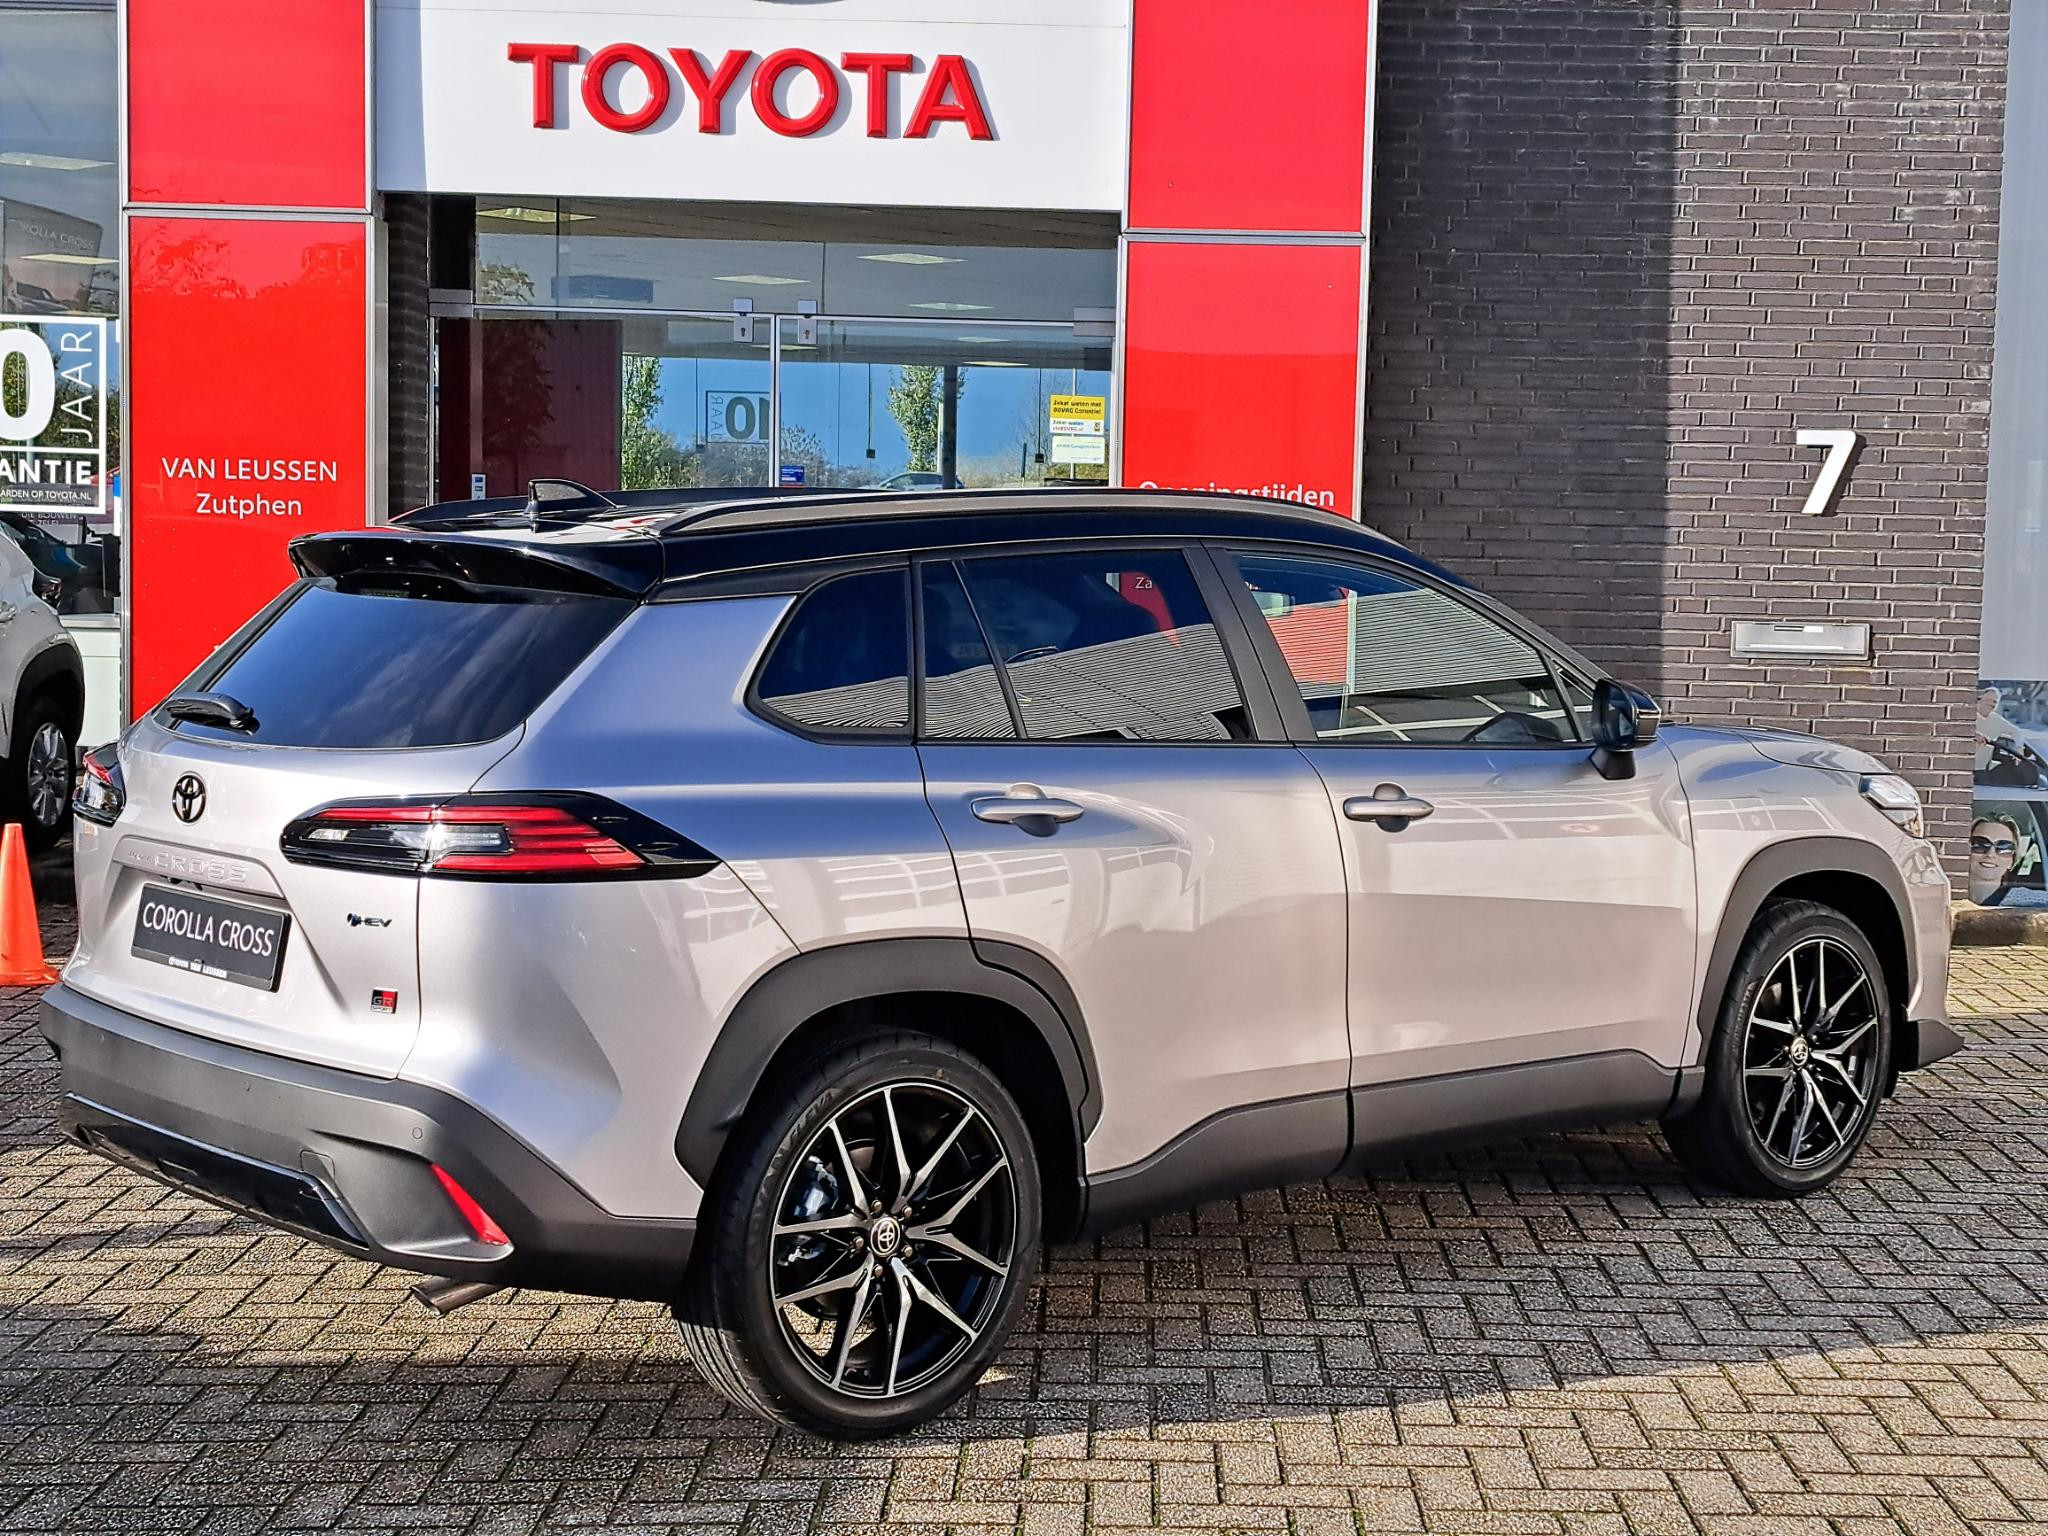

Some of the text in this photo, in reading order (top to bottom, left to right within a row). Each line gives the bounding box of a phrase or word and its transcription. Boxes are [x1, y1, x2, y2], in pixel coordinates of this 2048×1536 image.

[508, 42, 994, 140] TOYOTA
[60, 331, 92, 443] JAAR
[161, 457, 338, 482] VAN LEUSSEN
[1796, 430, 1857, 514] 7
[31, 490, 43, 498] OP
[45, 491, 92, 501] TOYOTA.NL
[196, 493, 303, 520] Zutphen
[1134, 577, 1154, 589] Za
[154, 852, 250, 883] CROSS
[142, 902, 275, 957] COROLLA CROSS
[373, 996, 394, 1007] GR
